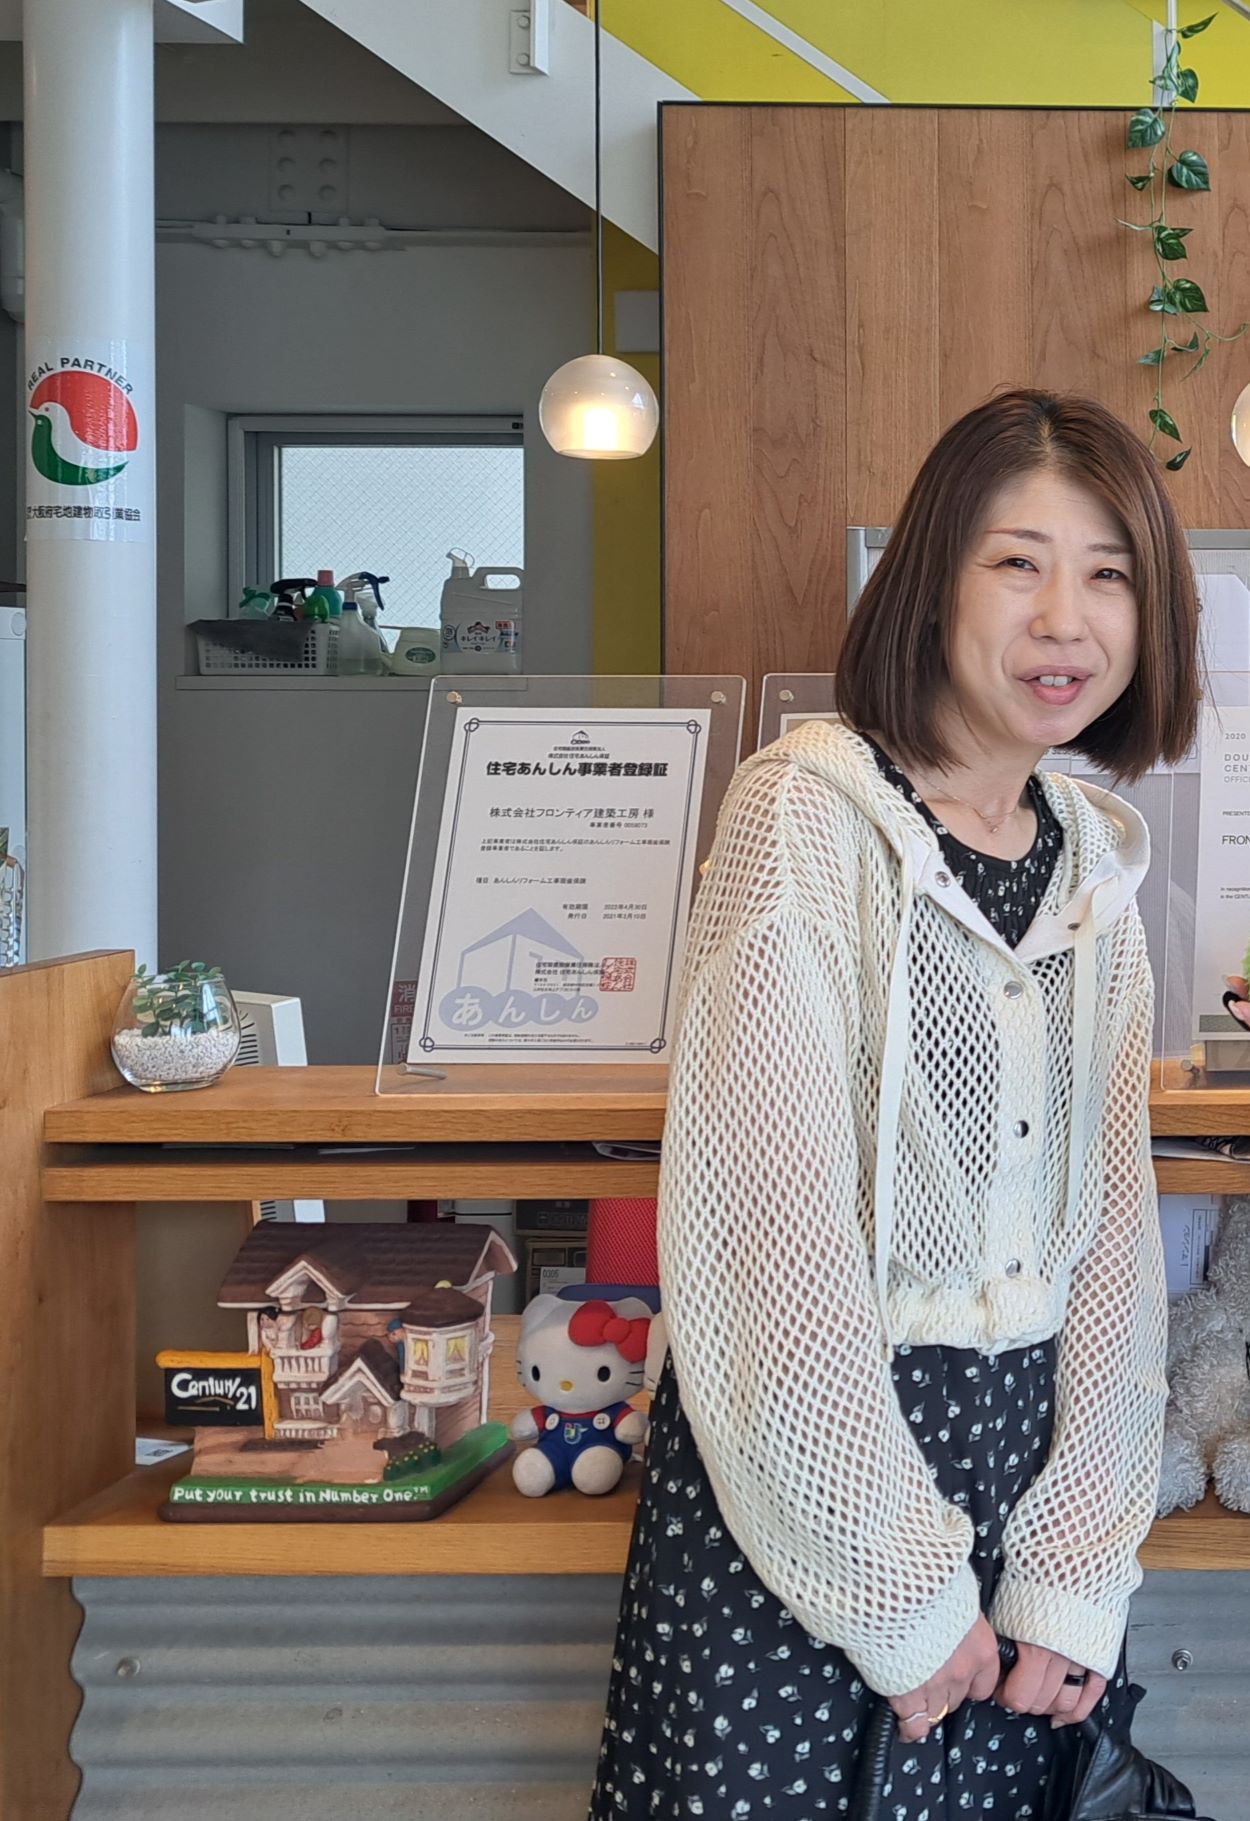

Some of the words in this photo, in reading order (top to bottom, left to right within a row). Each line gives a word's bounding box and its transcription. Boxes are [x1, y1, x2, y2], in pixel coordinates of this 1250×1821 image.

[27, 362, 54, 391] REAL
[60, 357, 134, 395] PARTNER
[486, 761, 668, 777] 住宅あんしん事業者登録証
[489, 807, 638, 819] 株式会社フロンティア建築工房
[453, 993, 593, 1025] あんしん
[171, 1372, 241, 1399] Century
[235, 1385, 257, 1410] 21
[173, 1487, 202, 1501] Put
[206, 1489, 243, 1502] your
[249, 1489, 294, 1502] trust
[299, 1489, 316, 1502] in
[318, 1489, 378, 1504] Number
